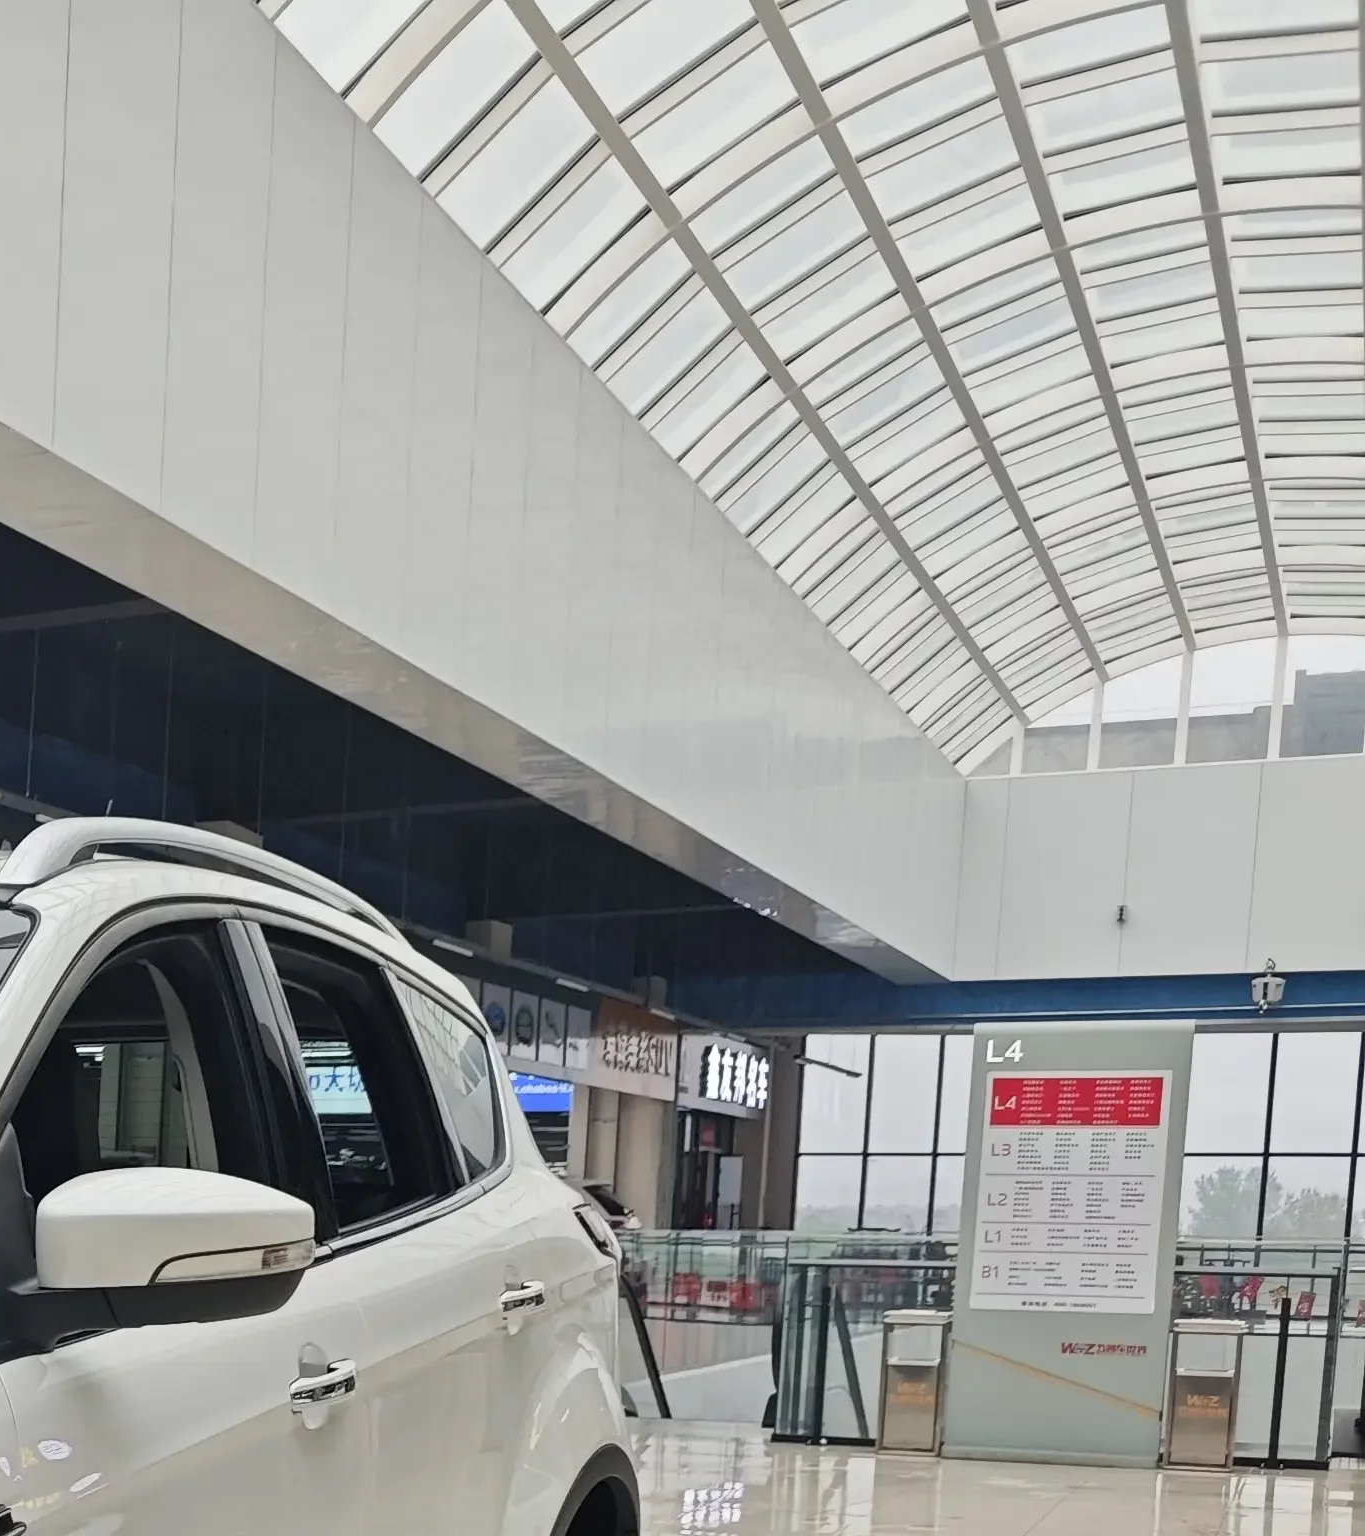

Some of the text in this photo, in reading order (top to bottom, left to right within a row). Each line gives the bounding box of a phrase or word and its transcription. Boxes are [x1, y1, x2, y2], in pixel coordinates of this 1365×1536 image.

[985, 1038, 1025, 1063] L4
[993, 1095, 1018, 1111] L4
[991, 1142, 1012, 1157] L3
[987, 1192, 1008, 1207] L2
[983, 1230, 1002, 1244] L1
[981, 1265, 1000, 1279] B1
